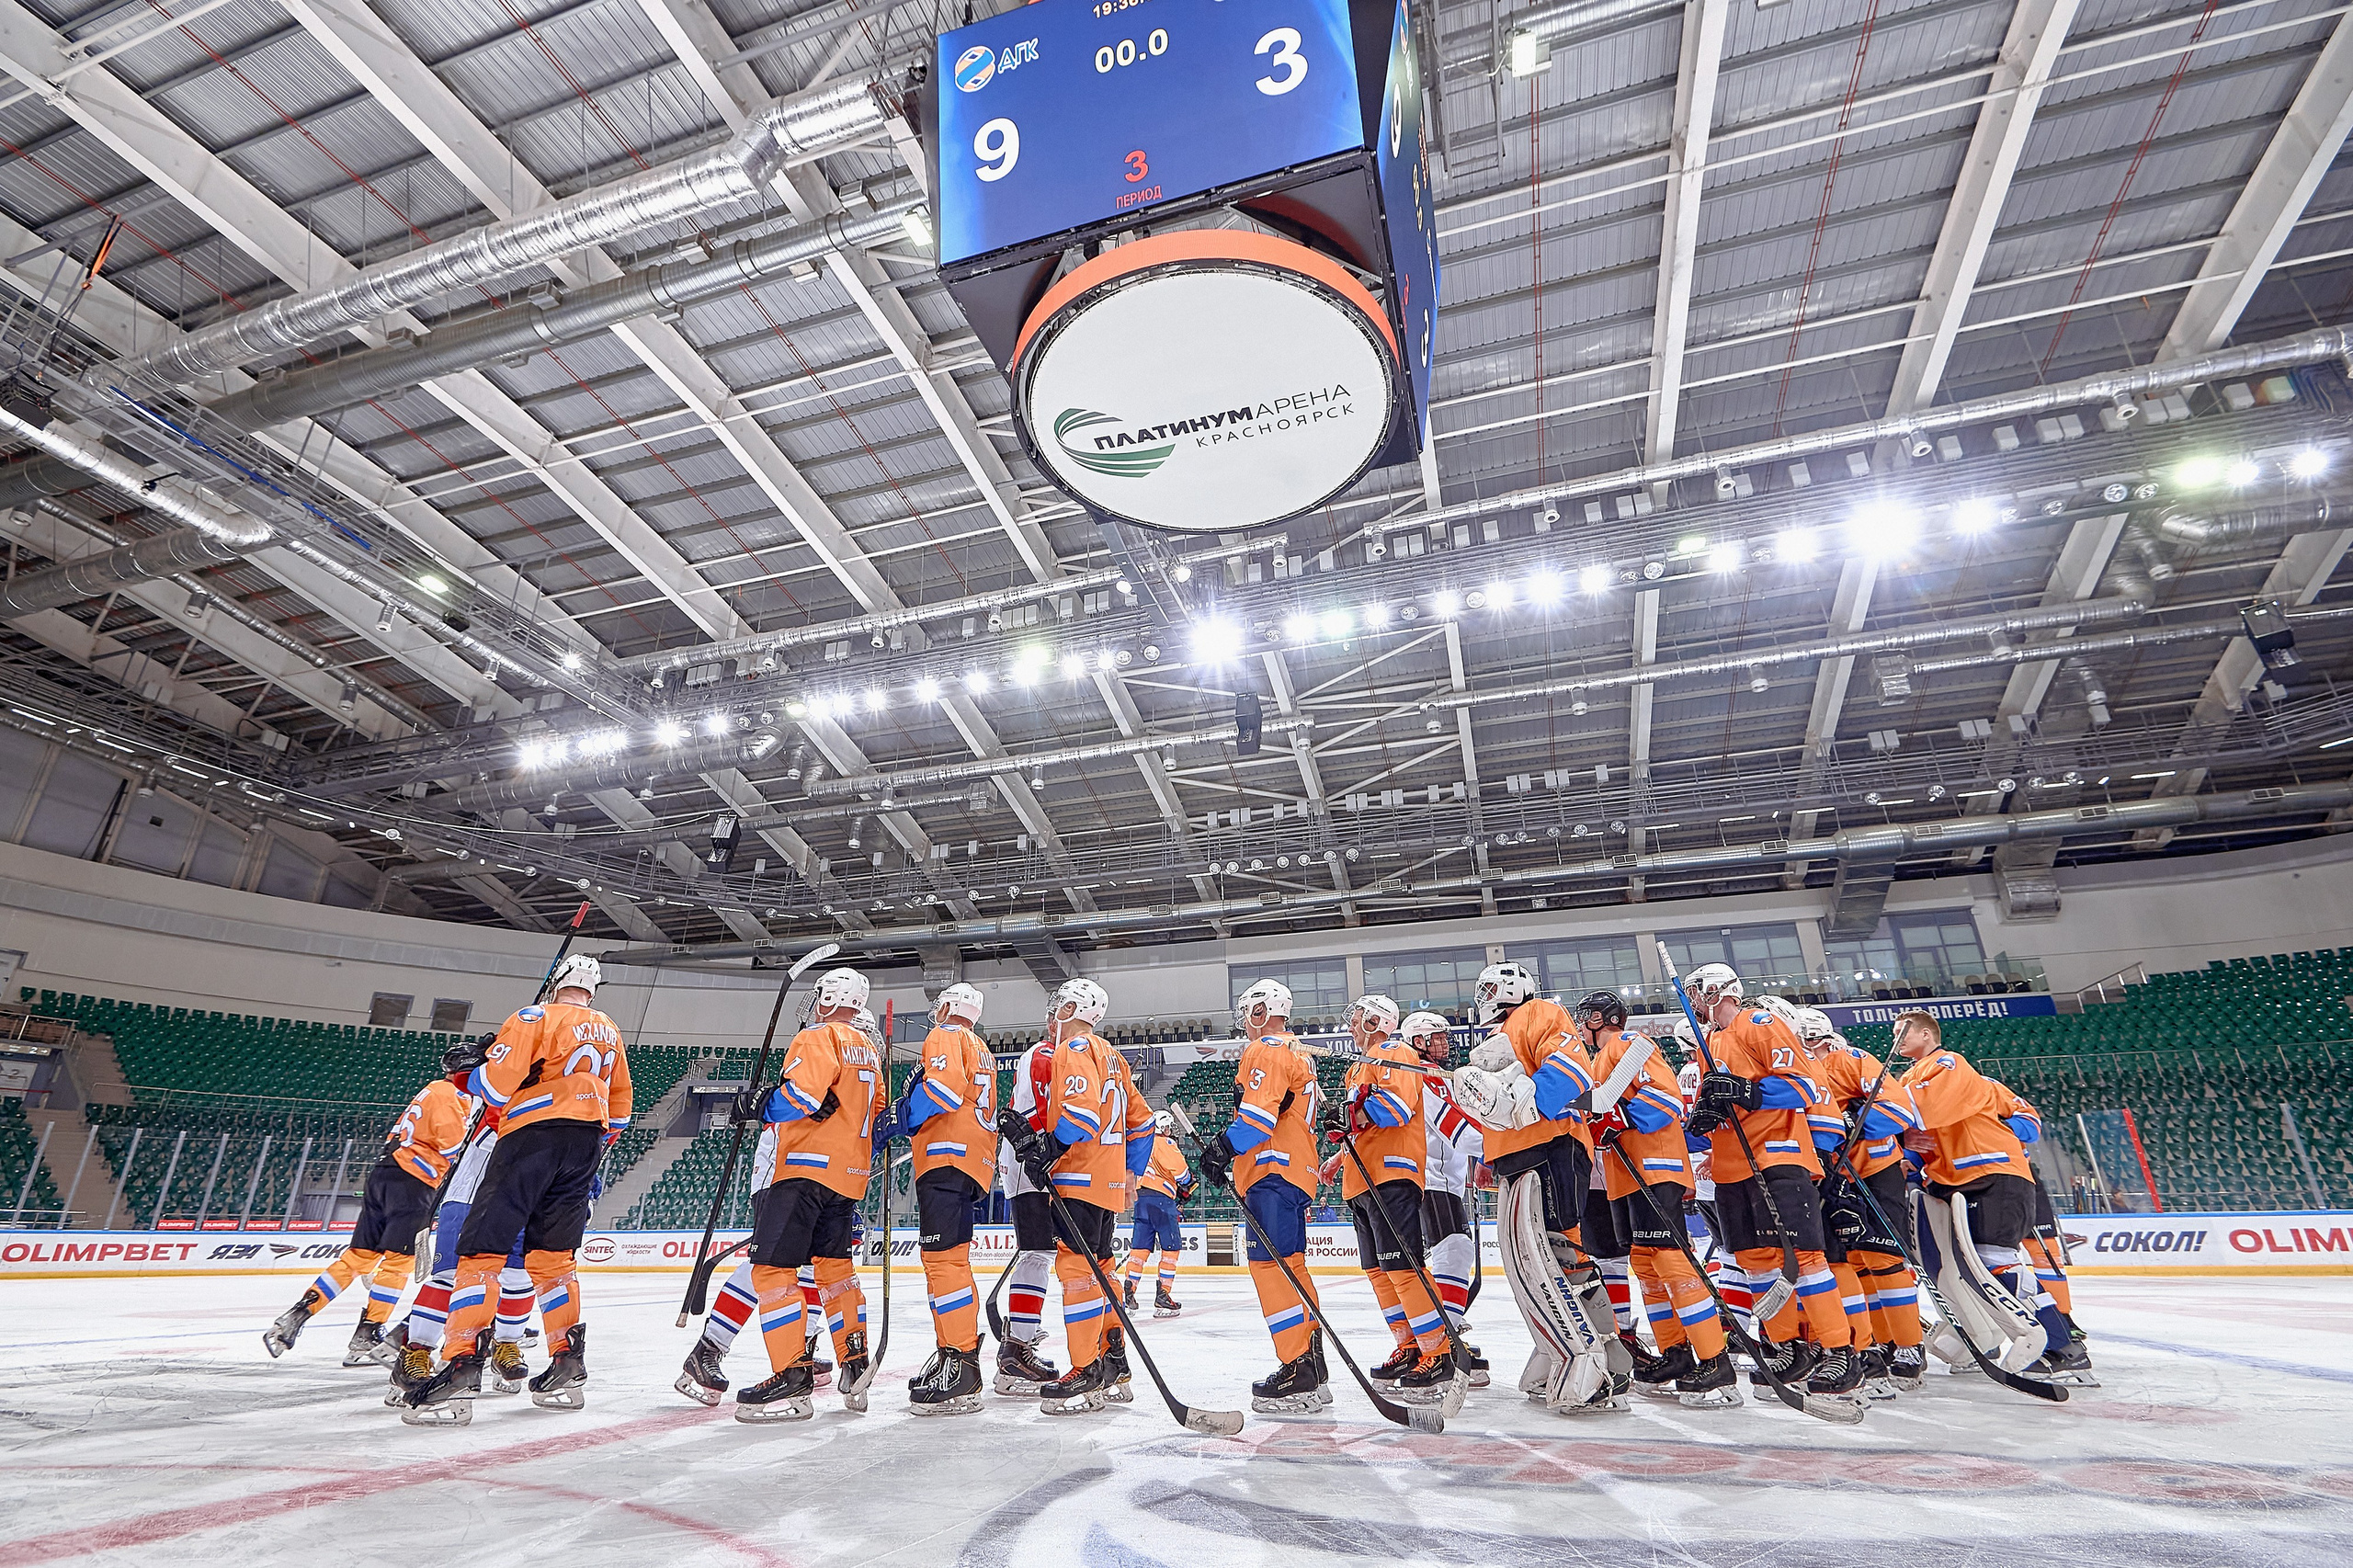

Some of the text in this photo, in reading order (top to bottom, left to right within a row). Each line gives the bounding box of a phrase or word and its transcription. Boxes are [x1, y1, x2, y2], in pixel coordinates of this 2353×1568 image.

[1094, 28, 1169, 74] 00.0
[1253, 26, 1309, 97] 3
[972, 117, 1021, 183] 9
[1124, 149, 1149, 183] 3
[1115, 187, 1163, 210] ПЕРИОД
[1196, 402, 1355, 449] КРАСНОЯРСК
[486, 1042, 512, 1064] 91
[1771, 1047, 1794, 1069] 27
[1064, 1074, 1088, 1096] 20
[858, 1070, 876, 1139] 7
[1632, 1230, 1672, 1239] BAUER
[2094, 1230, 2208, 1253] СОКОЛ!
[2228, 1227, 2353, 1254] OLIM
[2, 1243, 199, 1263] OLIMPBET
[584, 1245, 615, 1255] SINTEC
[1316, 1247, 1358, 1256] РОССИИ
[1540, 1281, 1574, 1341] VAUGHN
[1553, 1276, 1596, 1346] VAUGHN
[1914, 1264, 1962, 1328] BAUER
[1982, 1282, 2040, 1328] CCM
